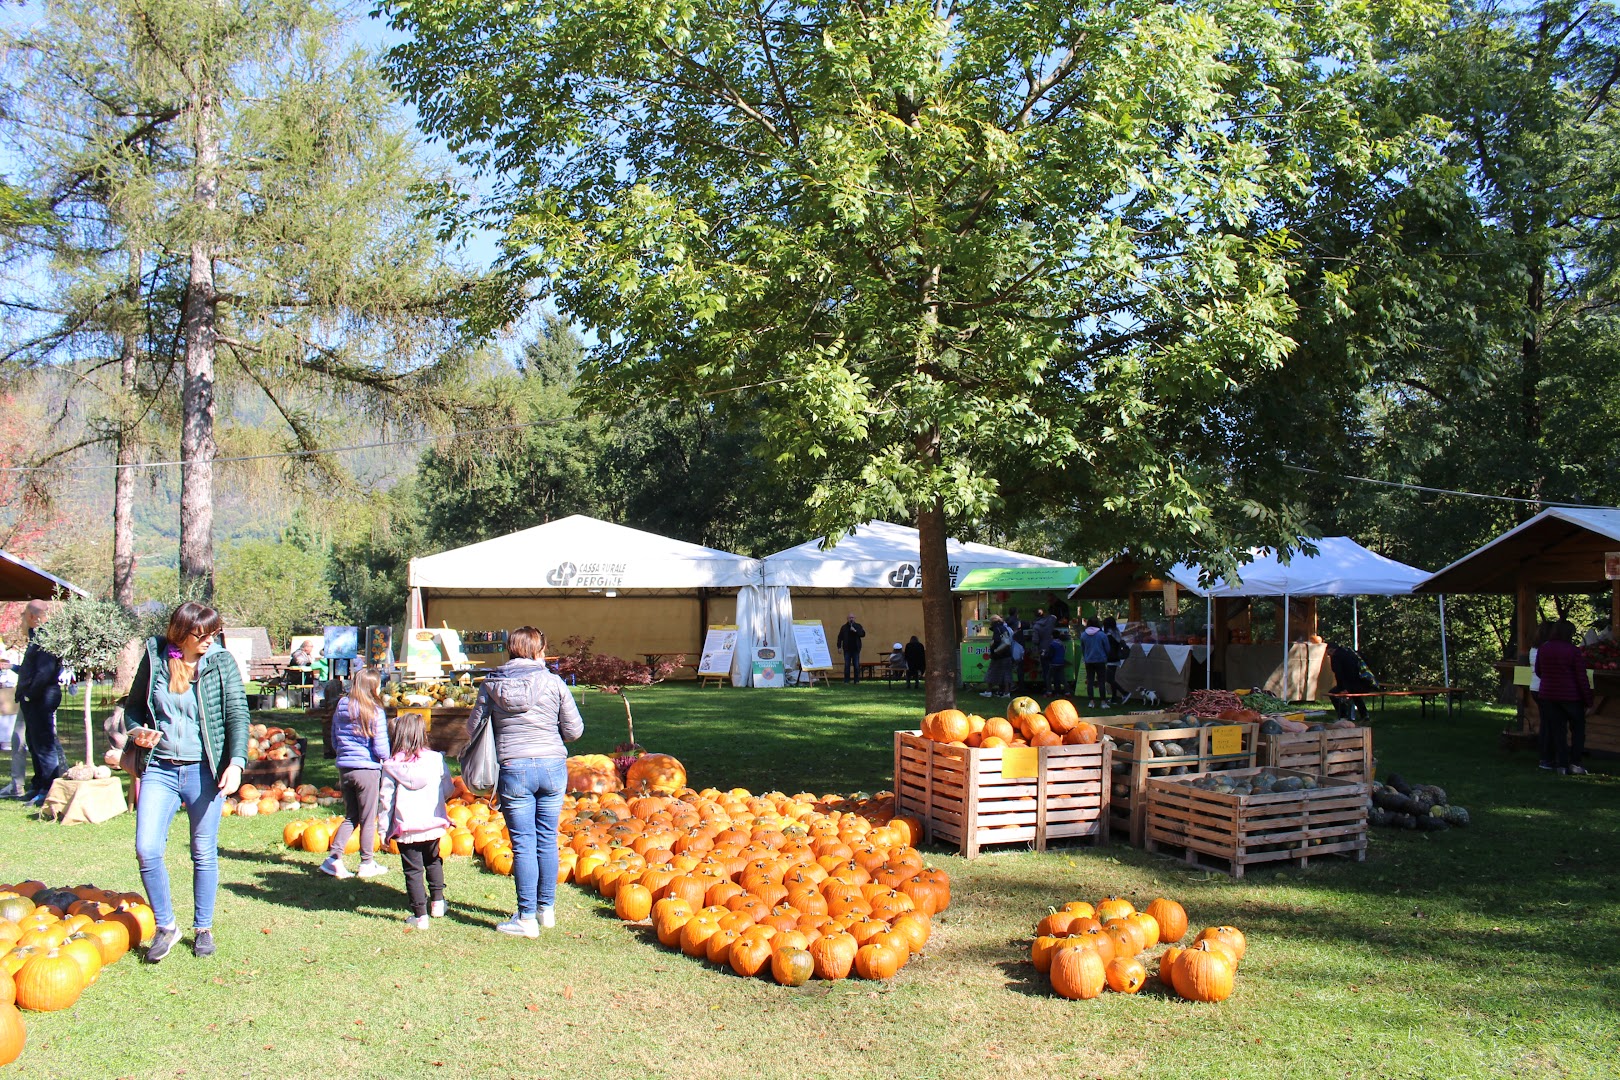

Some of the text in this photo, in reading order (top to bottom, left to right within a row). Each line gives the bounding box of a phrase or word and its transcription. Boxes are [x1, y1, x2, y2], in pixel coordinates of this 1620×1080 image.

[580, 563, 626, 573] CASSA RURALE
[576, 577, 622, 586] PERGINE
